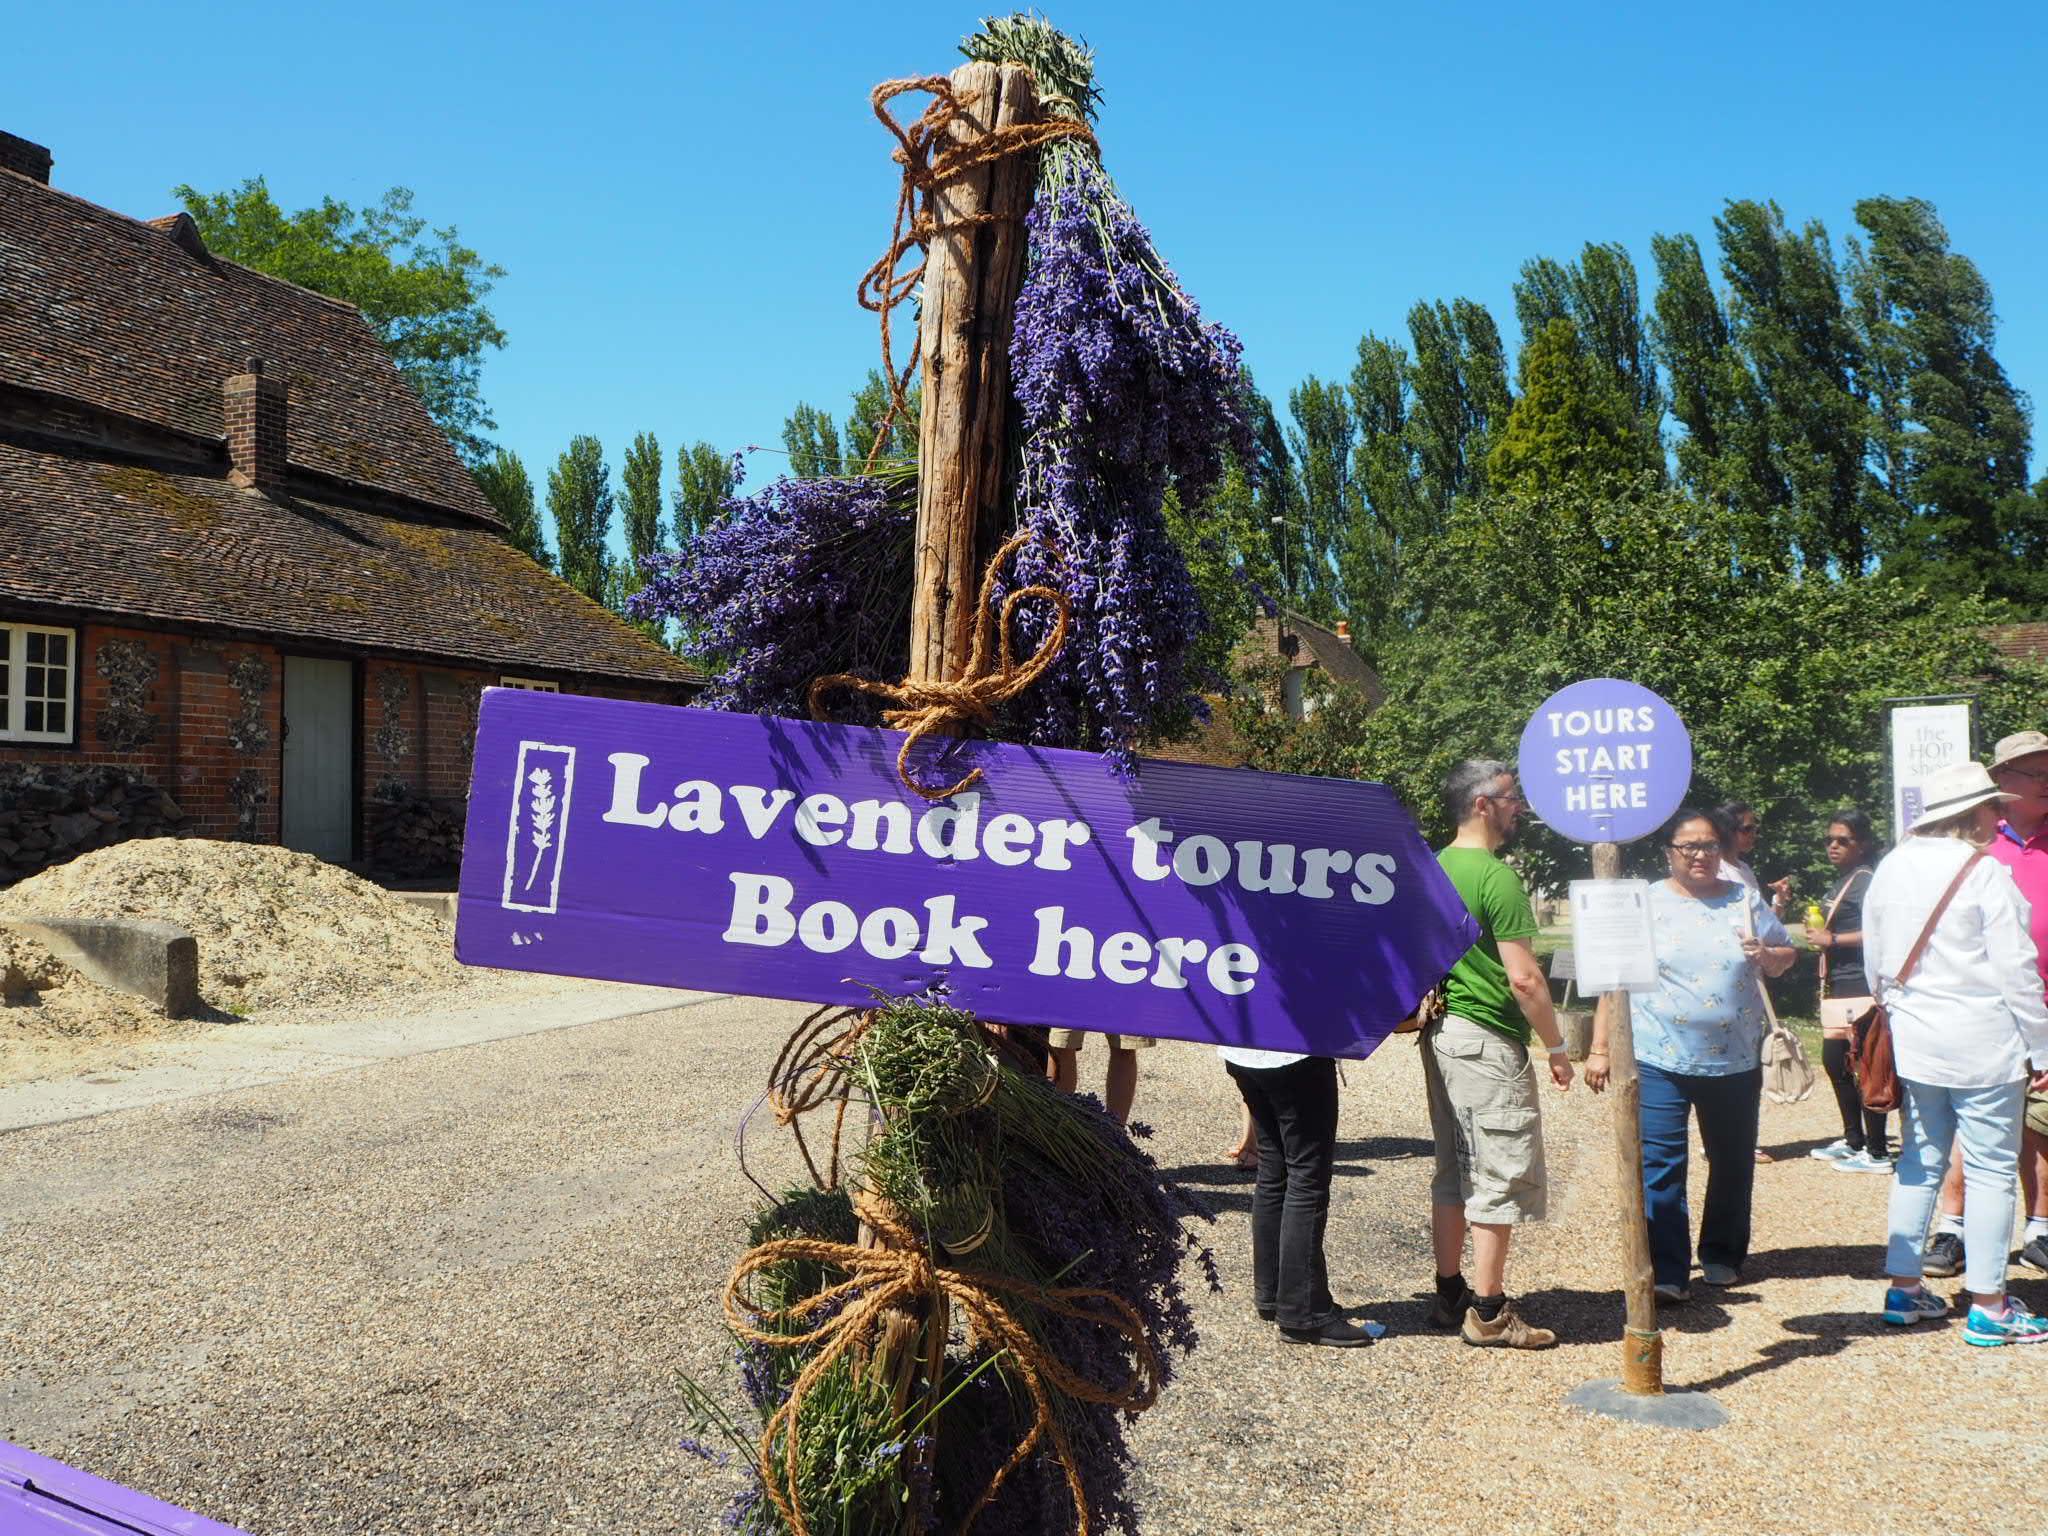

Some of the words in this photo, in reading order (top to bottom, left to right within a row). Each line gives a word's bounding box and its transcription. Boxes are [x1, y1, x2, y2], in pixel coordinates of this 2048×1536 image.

[1547, 705, 1656, 738] TOURS
[1555, 744, 1653, 775] START
[1564, 782, 1648, 812] HERE
[601, 751, 1091, 871] Lavender
[1126, 816, 1397, 905] tours
[721, 871, 993, 969] Book
[1028, 905, 1260, 996] here
